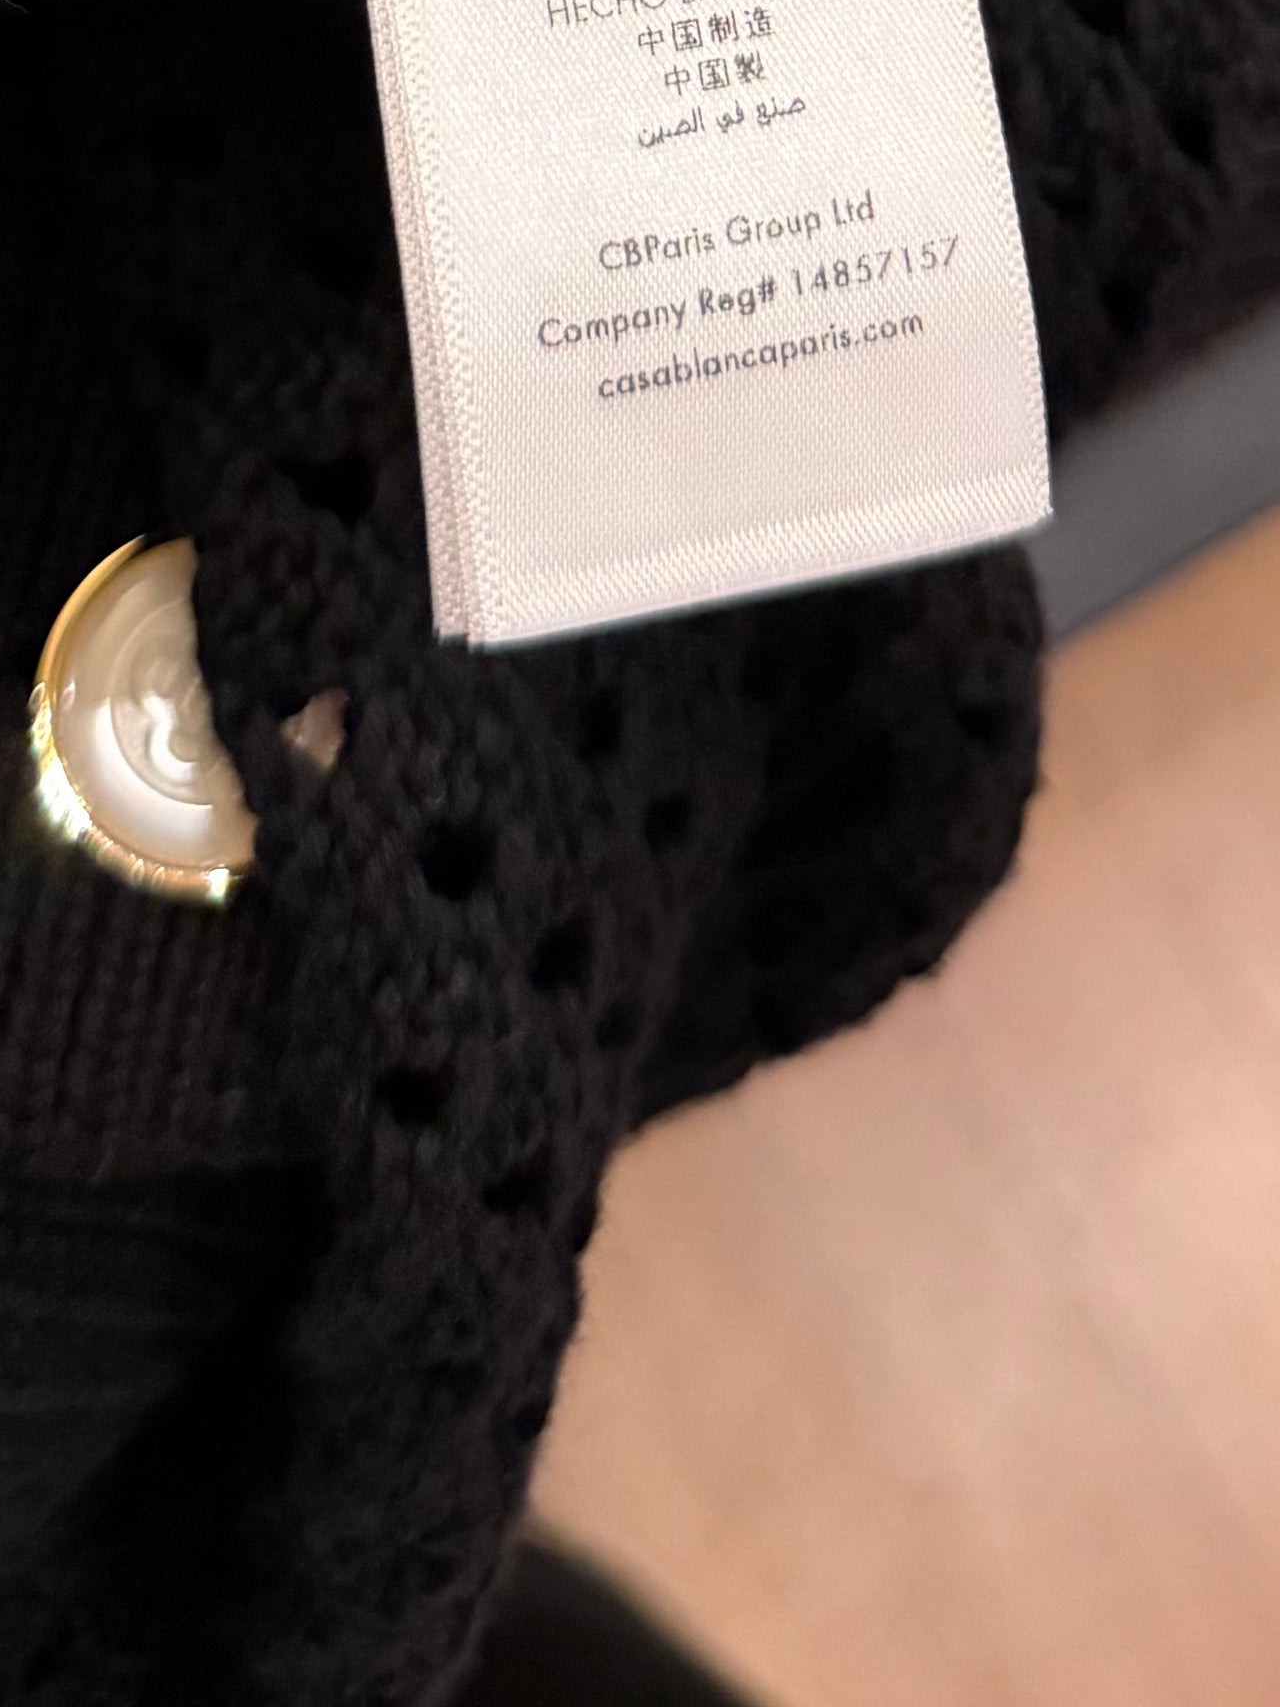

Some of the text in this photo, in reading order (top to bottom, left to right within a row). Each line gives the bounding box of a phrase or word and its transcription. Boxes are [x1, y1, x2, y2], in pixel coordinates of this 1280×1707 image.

[637, 5, 777, 56] 中国制造
[637, 95, 807, 149] صنع في الصين
[597, 188, 876, 271] CBParis Group Ltd
[537, 233, 960, 348] Company Reg# 14857157
[596, 311, 925, 400] casablancaparis.com
